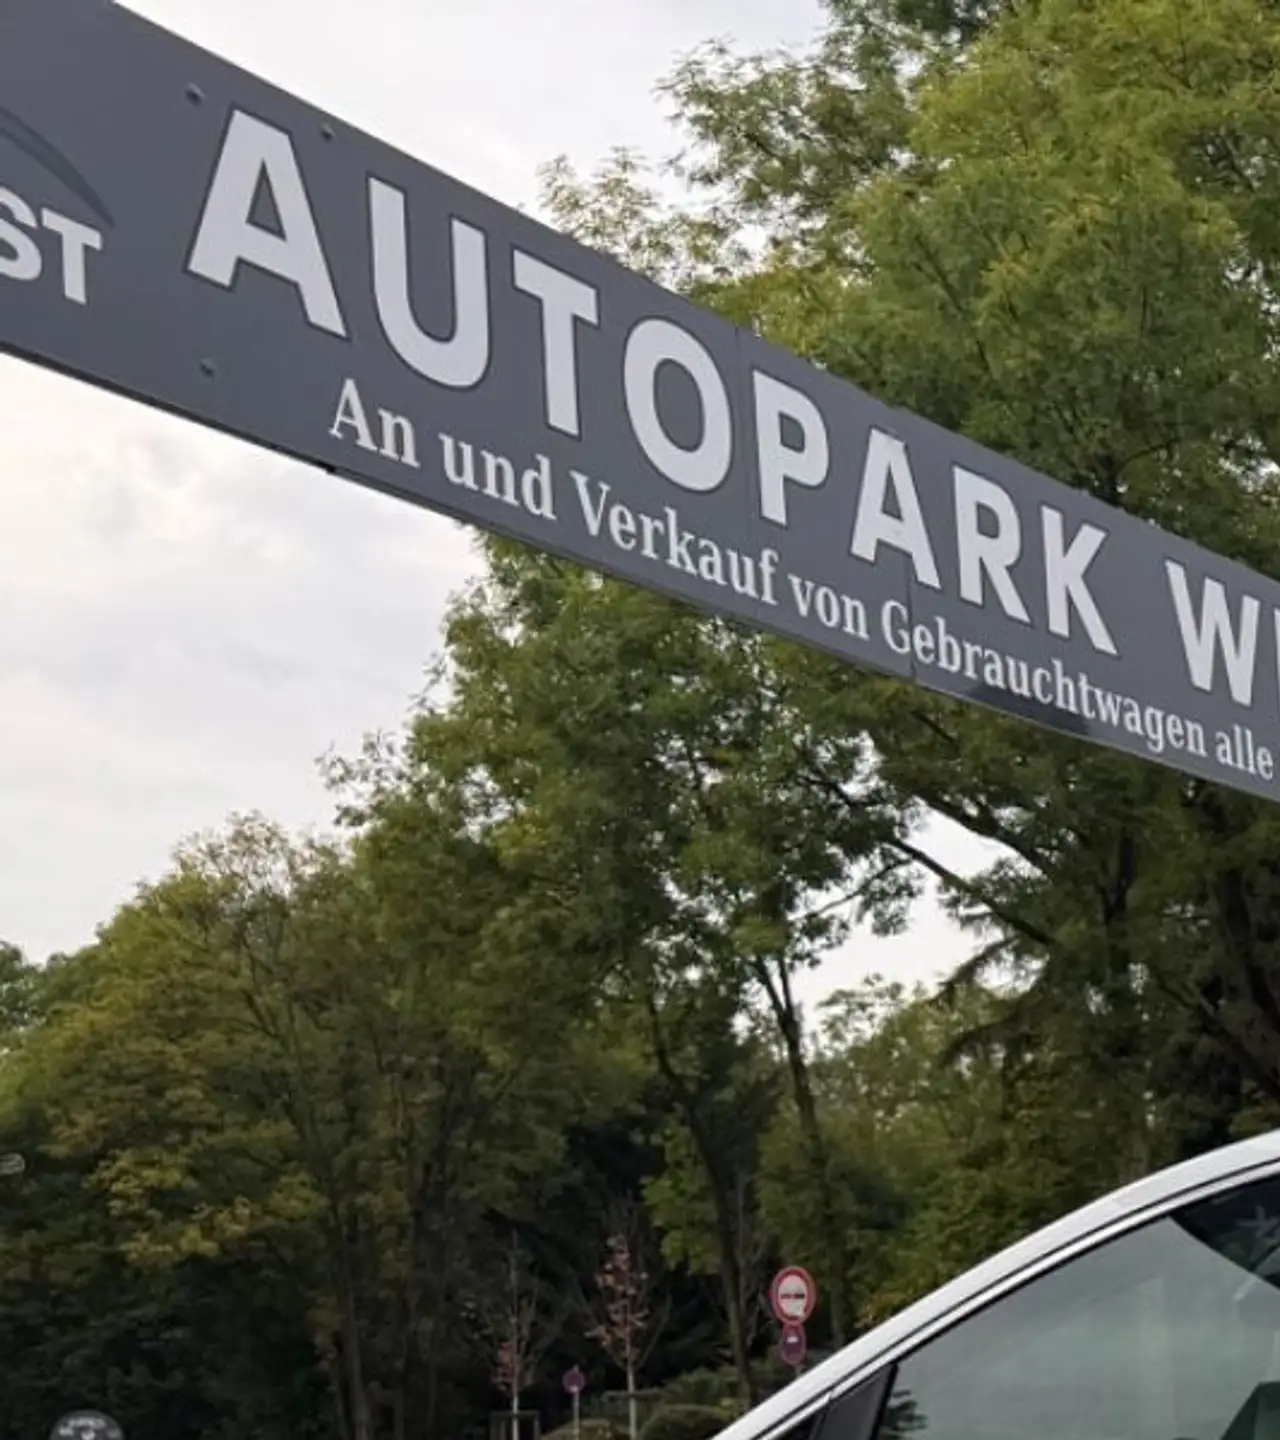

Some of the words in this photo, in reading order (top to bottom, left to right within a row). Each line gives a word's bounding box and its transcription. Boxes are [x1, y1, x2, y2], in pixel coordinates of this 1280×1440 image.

[189, 110, 1117, 655] AUTOPARK
[329, 378, 420, 468] An
[439, 434, 557, 521] und
[570, 470, 781, 606] Verkauf
[787, 574, 869, 640] von
[881, 599, 1206, 754] Gebrauchtwagen
[1215, 727, 1274, 780] alle
